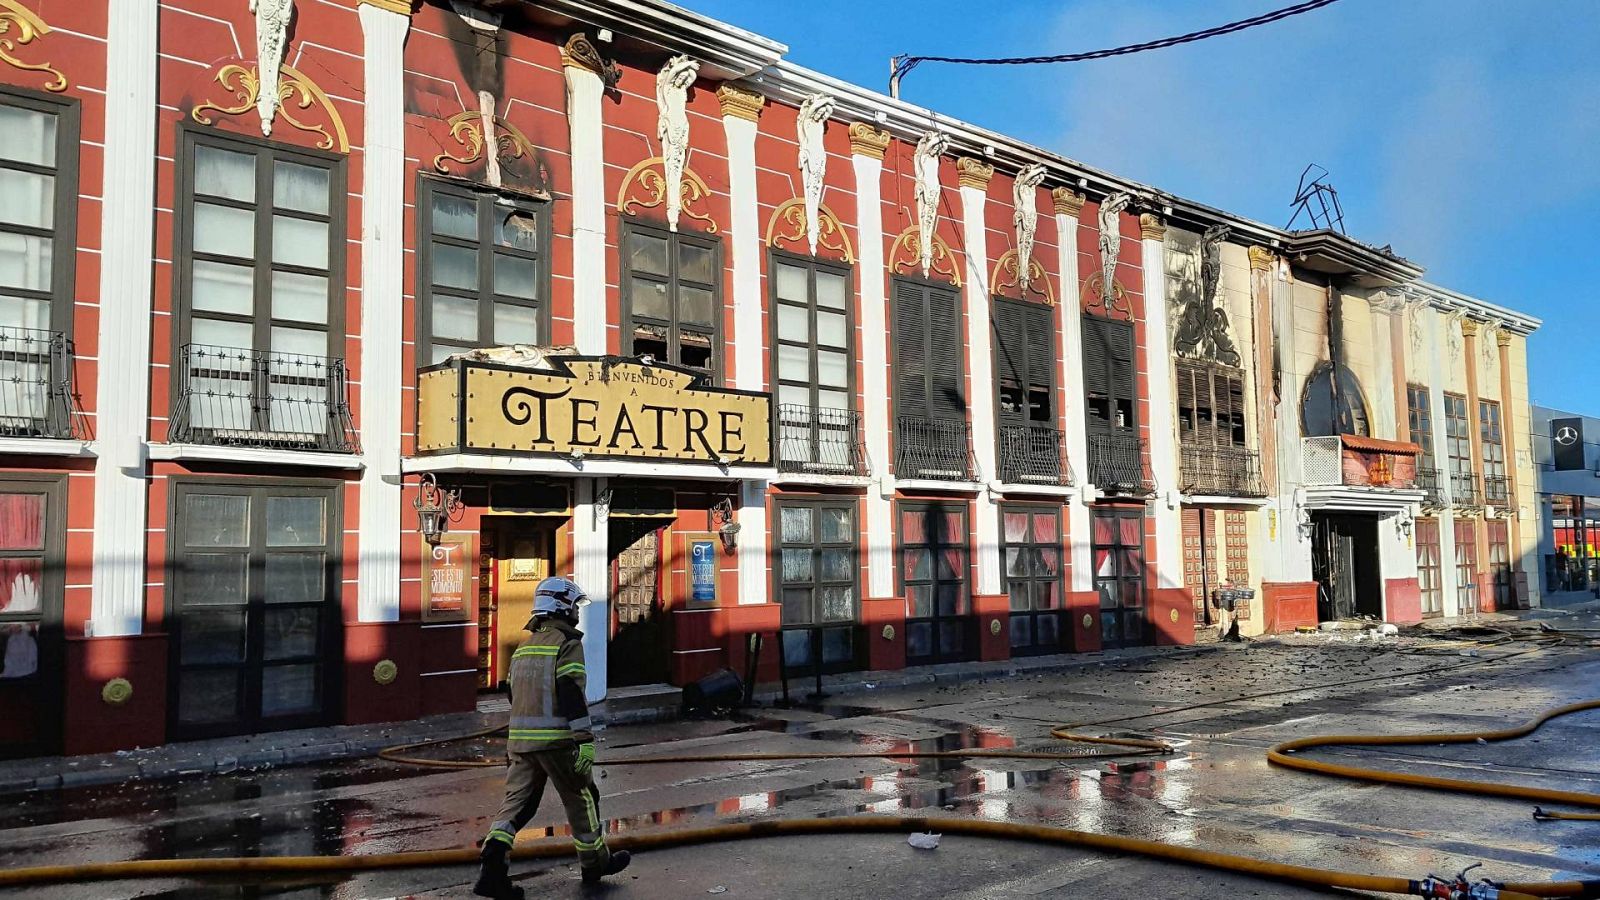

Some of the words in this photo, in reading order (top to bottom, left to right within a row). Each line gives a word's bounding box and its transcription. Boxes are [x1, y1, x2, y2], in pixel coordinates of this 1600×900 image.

[588, 371, 674, 389] BINVENIDOS
[630, 387, 638, 397] A
[501, 386, 746, 462] TEATRE
